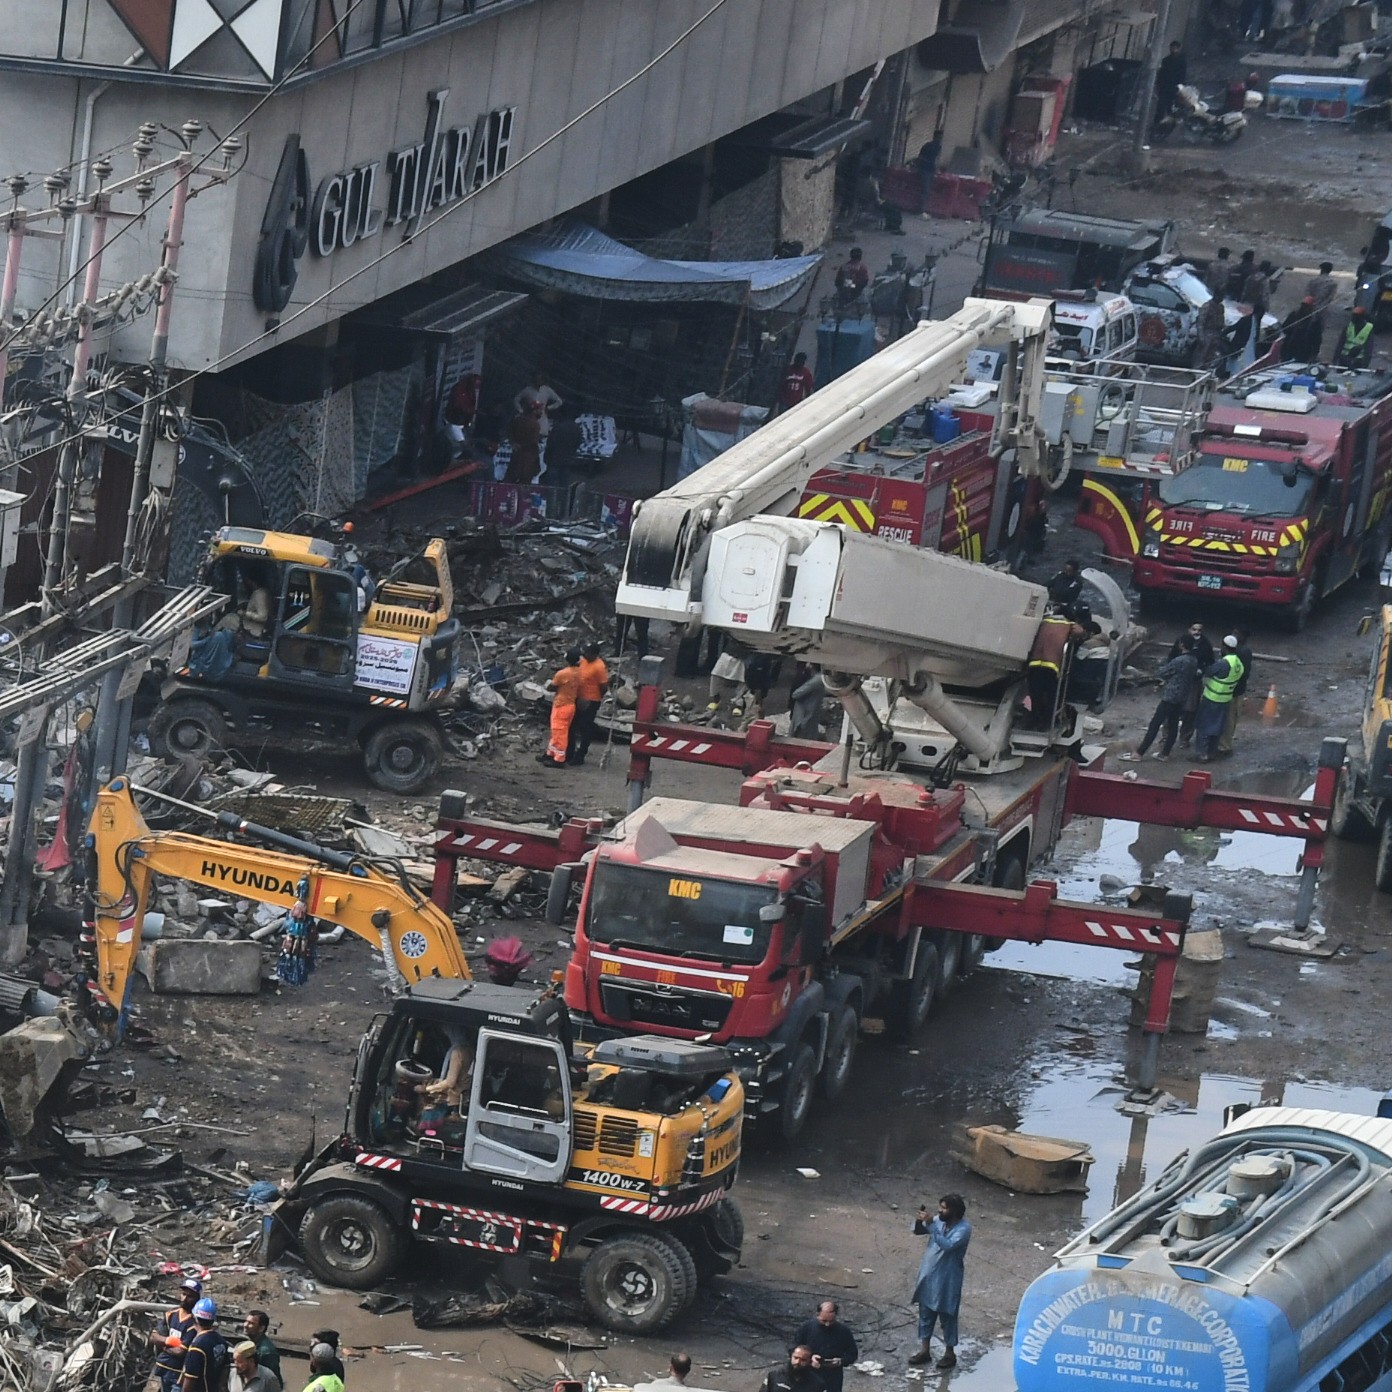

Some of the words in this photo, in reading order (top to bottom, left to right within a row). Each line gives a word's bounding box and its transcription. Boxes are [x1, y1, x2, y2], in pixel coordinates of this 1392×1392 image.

[314, 161, 380, 257] GUL
[390, 88, 518, 238] TIJARAH
[1223, 458, 1248, 473] KMC
[878, 525, 913, 544] RESCUE
[1251, 529, 1276, 543] FIRE
[240, 546, 267, 555] VOLVO
[201, 860, 297, 897] HYUNDA
[668, 878, 702, 900] KMC
[601, 960, 622, 976] KMC
[488, 1014, 521, 1025] HYUNDAI
[491, 1179, 524, 1190] HYUNDAI
